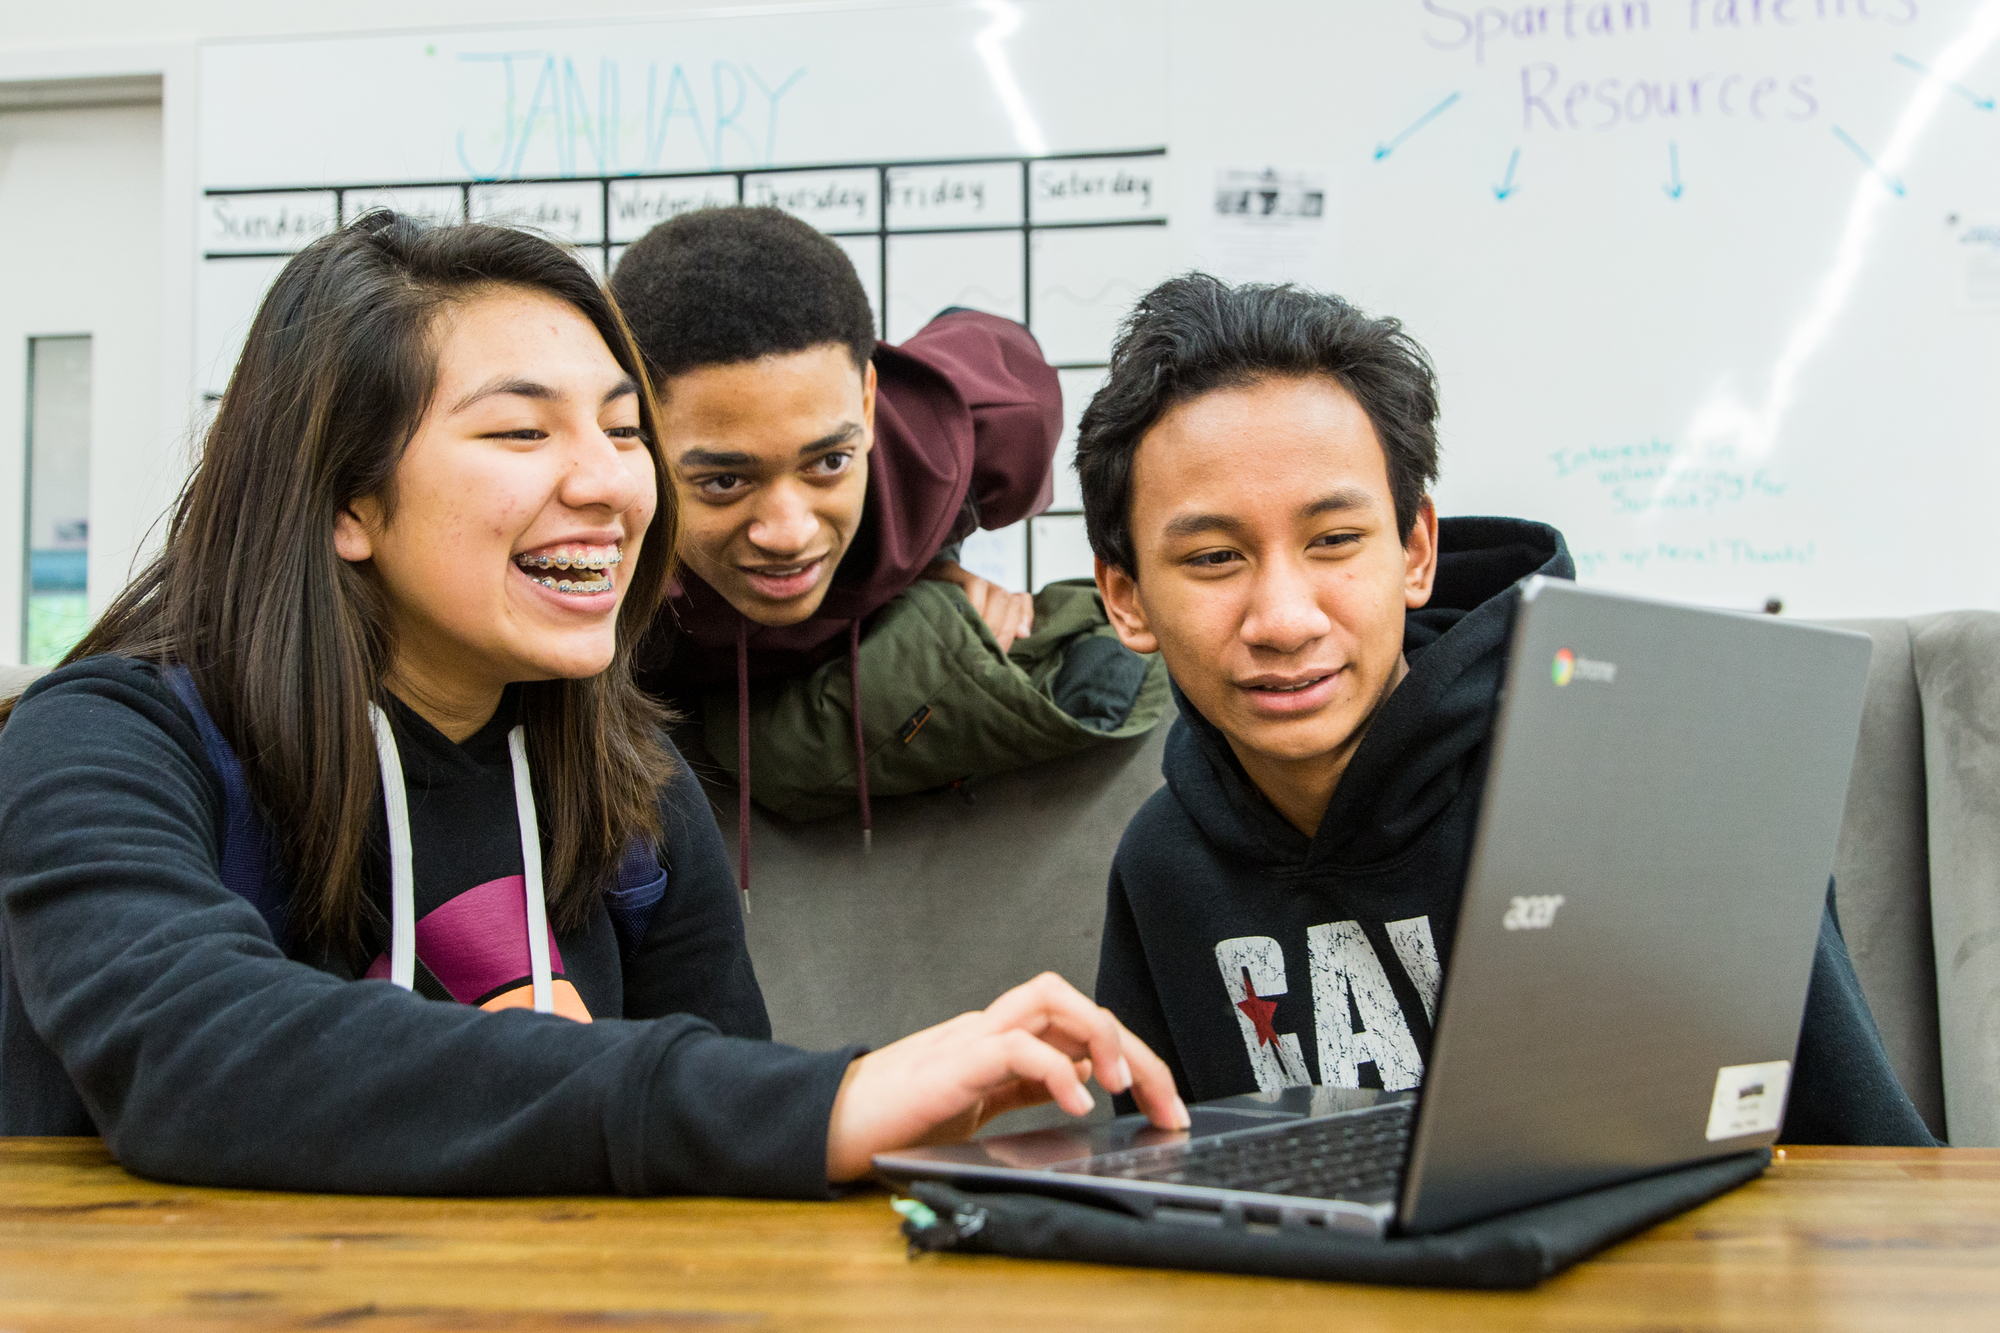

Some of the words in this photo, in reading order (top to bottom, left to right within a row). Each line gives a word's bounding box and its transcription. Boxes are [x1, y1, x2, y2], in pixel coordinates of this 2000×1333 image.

[1420, 0, 1653, 64] Spartan
[455, 48, 810, 180] JANUARY
[1519, 61, 1820, 132] Resources
[884, 169, 986, 213] Friday
[1037, 169, 1152, 209] Saturday
[1503, 893, 1566, 932] acer
